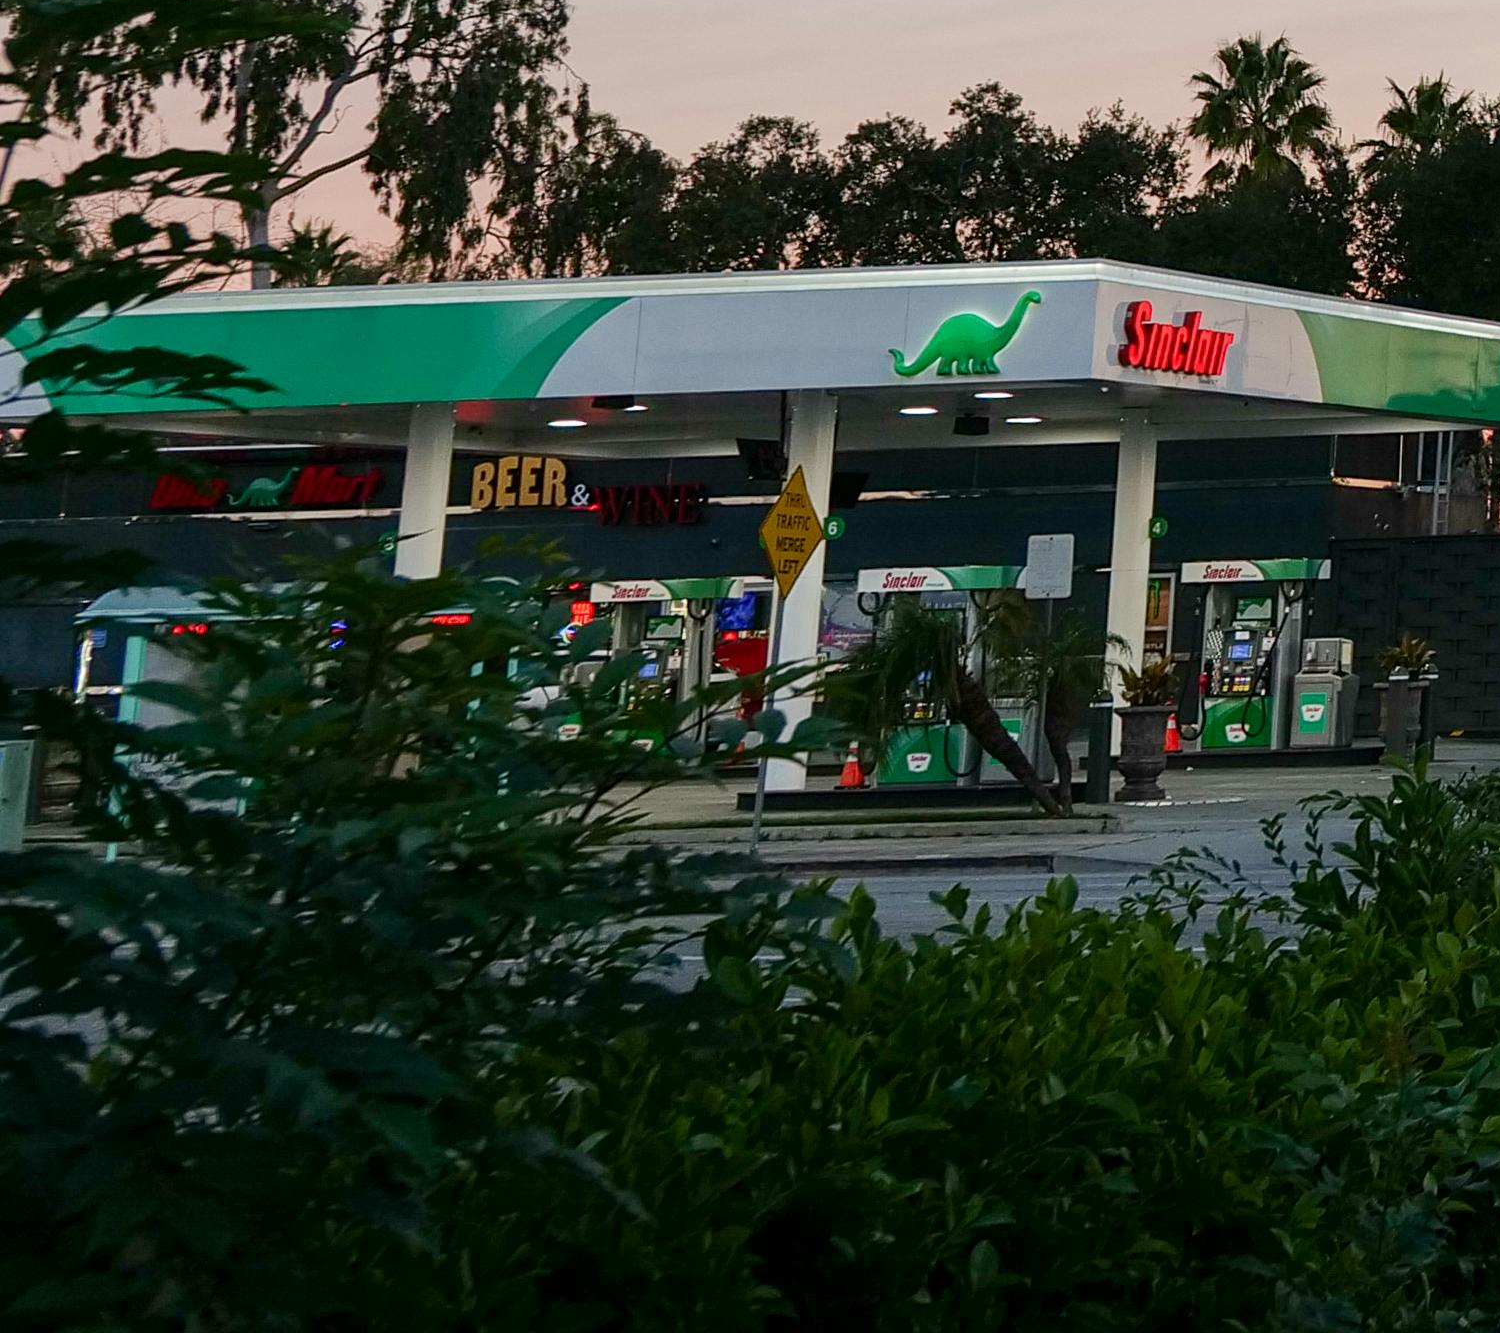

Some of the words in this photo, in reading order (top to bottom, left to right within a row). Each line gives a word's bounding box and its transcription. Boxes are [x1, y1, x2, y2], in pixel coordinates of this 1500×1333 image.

[1119, 300, 1235, 376] Sinclair
[289, 464, 384, 505] Mart
[471, 456, 568, 509] BEER
[571, 484, 590, 507] &
[594, 484, 703, 526] WINE
[776, 514, 811, 531] TRAFFIC
[828, 521, 838, 535] 6
[1152, 522, 1162, 534] 4
[776, 536, 806, 552] MERGE
[778, 559, 799, 574] LEFT
[1202, 564, 1243, 580] Sinclair
[882, 571, 928, 589] Sinclair
[611, 585, 651, 600] Sinclair
